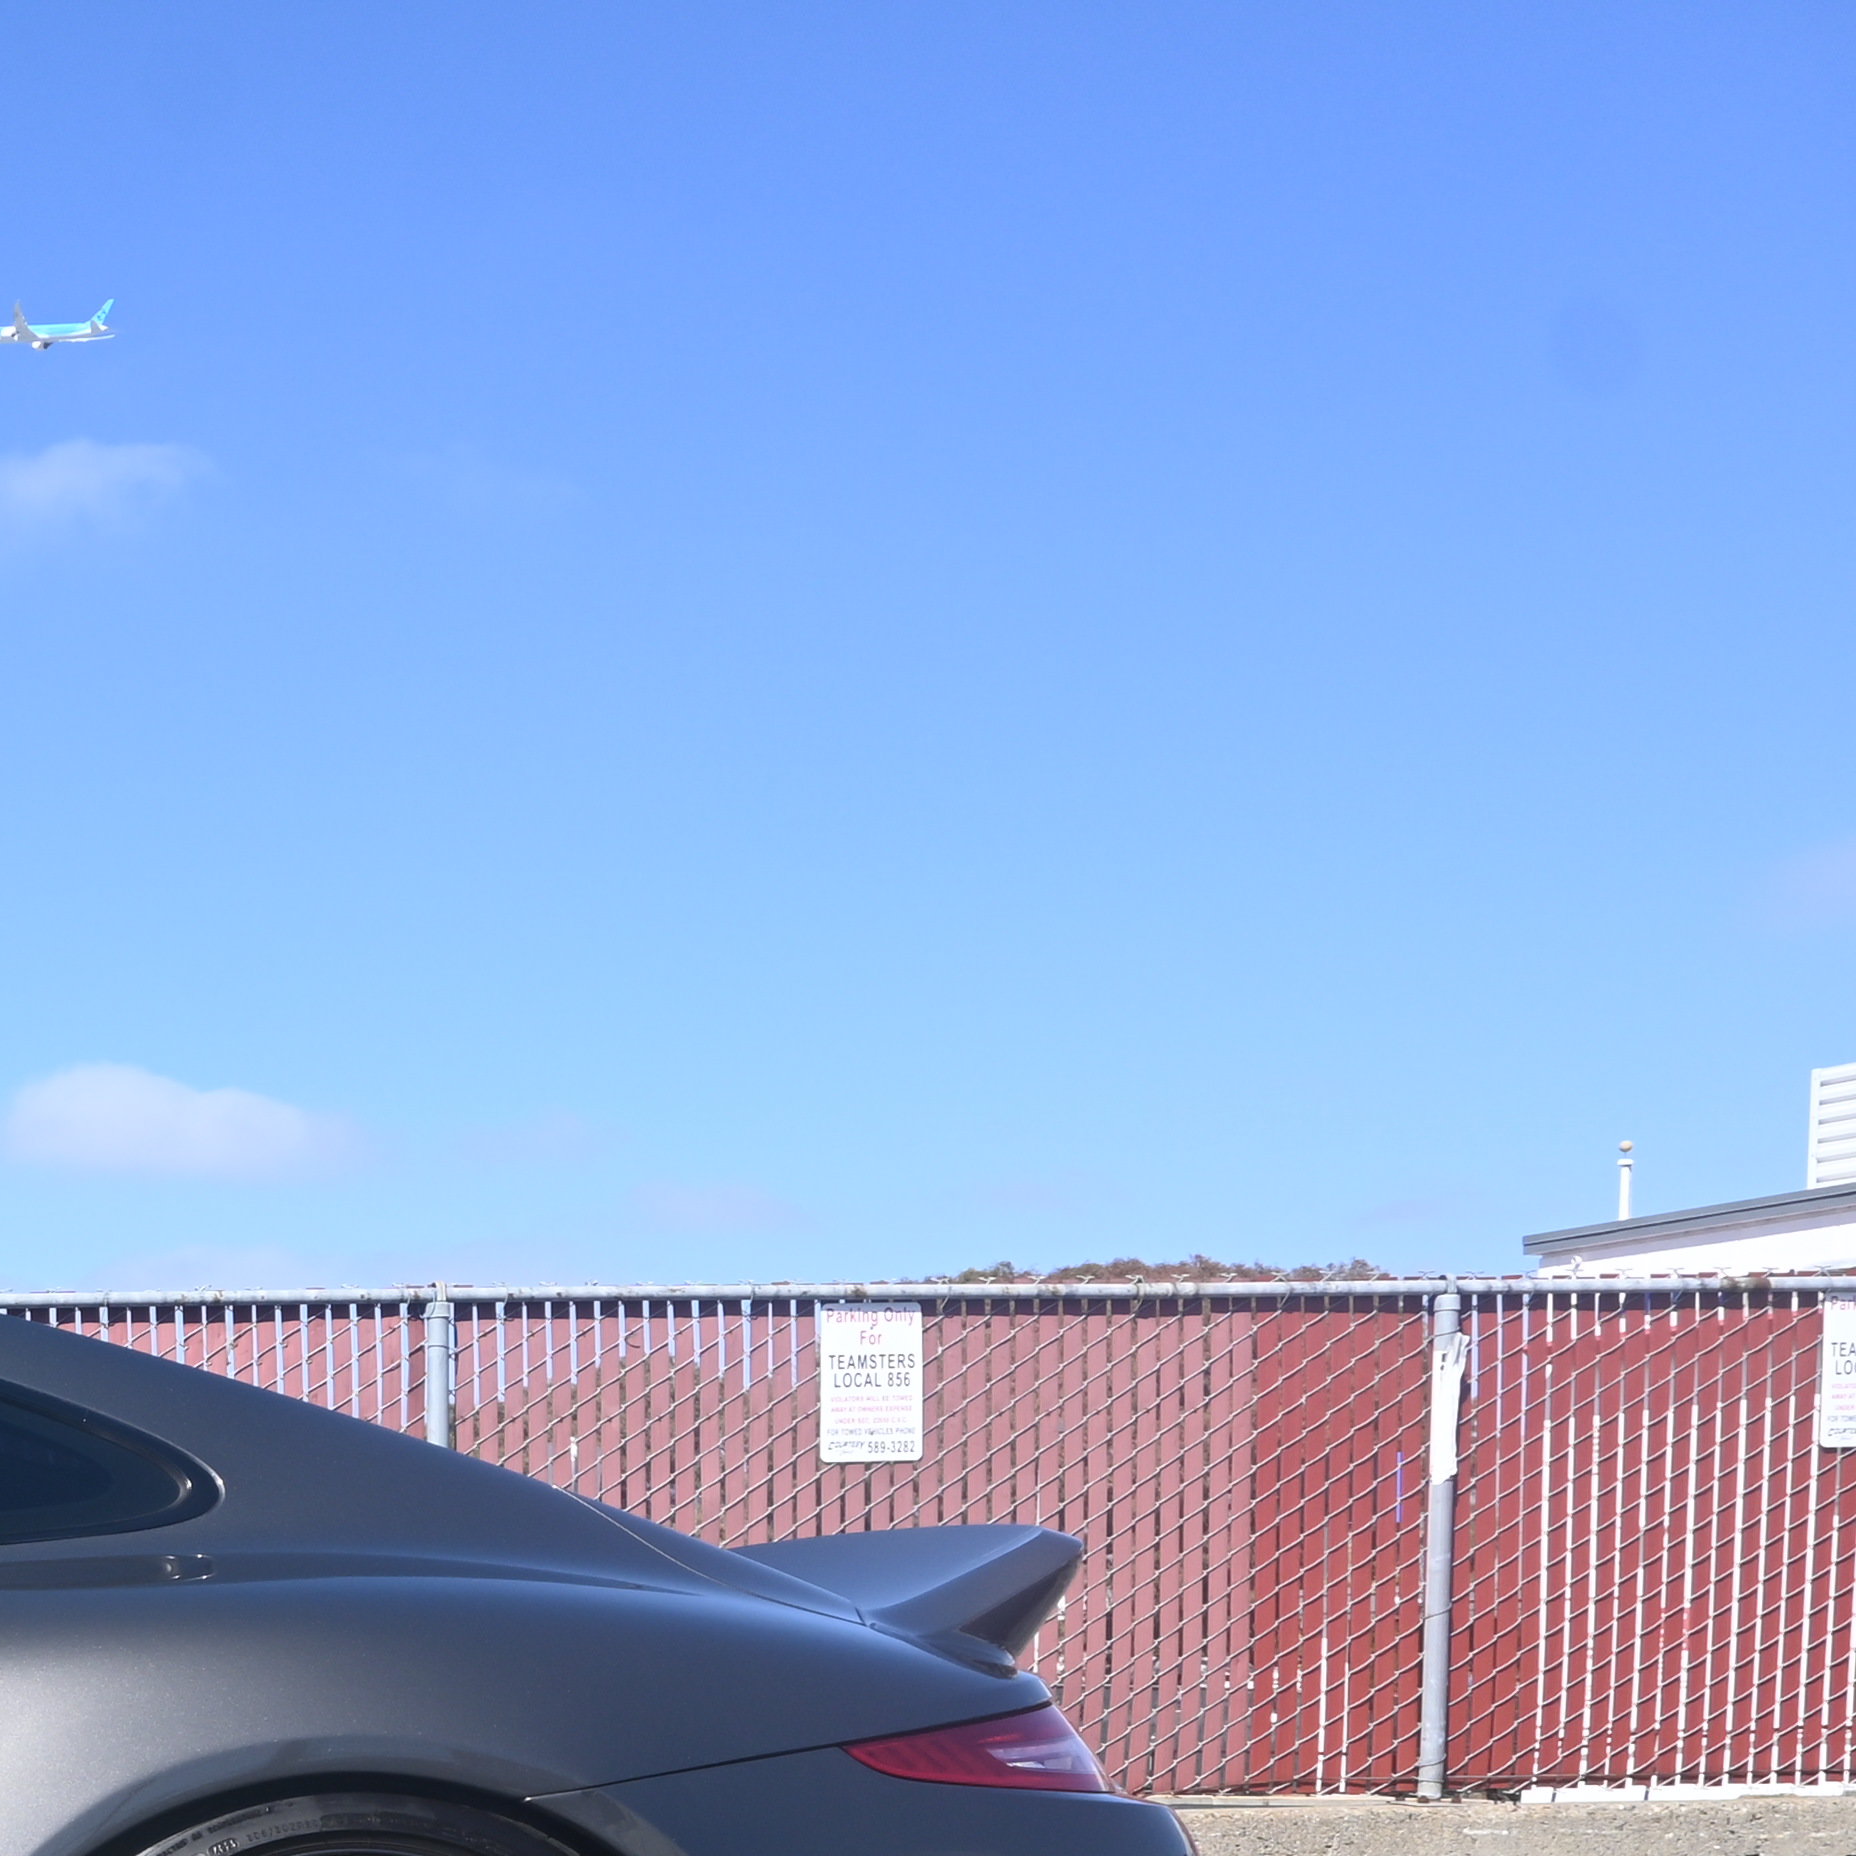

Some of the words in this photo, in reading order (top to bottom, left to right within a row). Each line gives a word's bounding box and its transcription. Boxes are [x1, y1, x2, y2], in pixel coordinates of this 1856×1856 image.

[826, 1308, 879, 1326] Parking
[884, 1306, 916, 1326] Only
[860, 1331, 882, 1345] For
[829, 1354, 915, 1370] TEAMSTERS
[834, 1372, 882, 1388] LOCAL
[887, 1372, 911, 1387] 856
[867, 1440, 916, 1453] 589-3282
